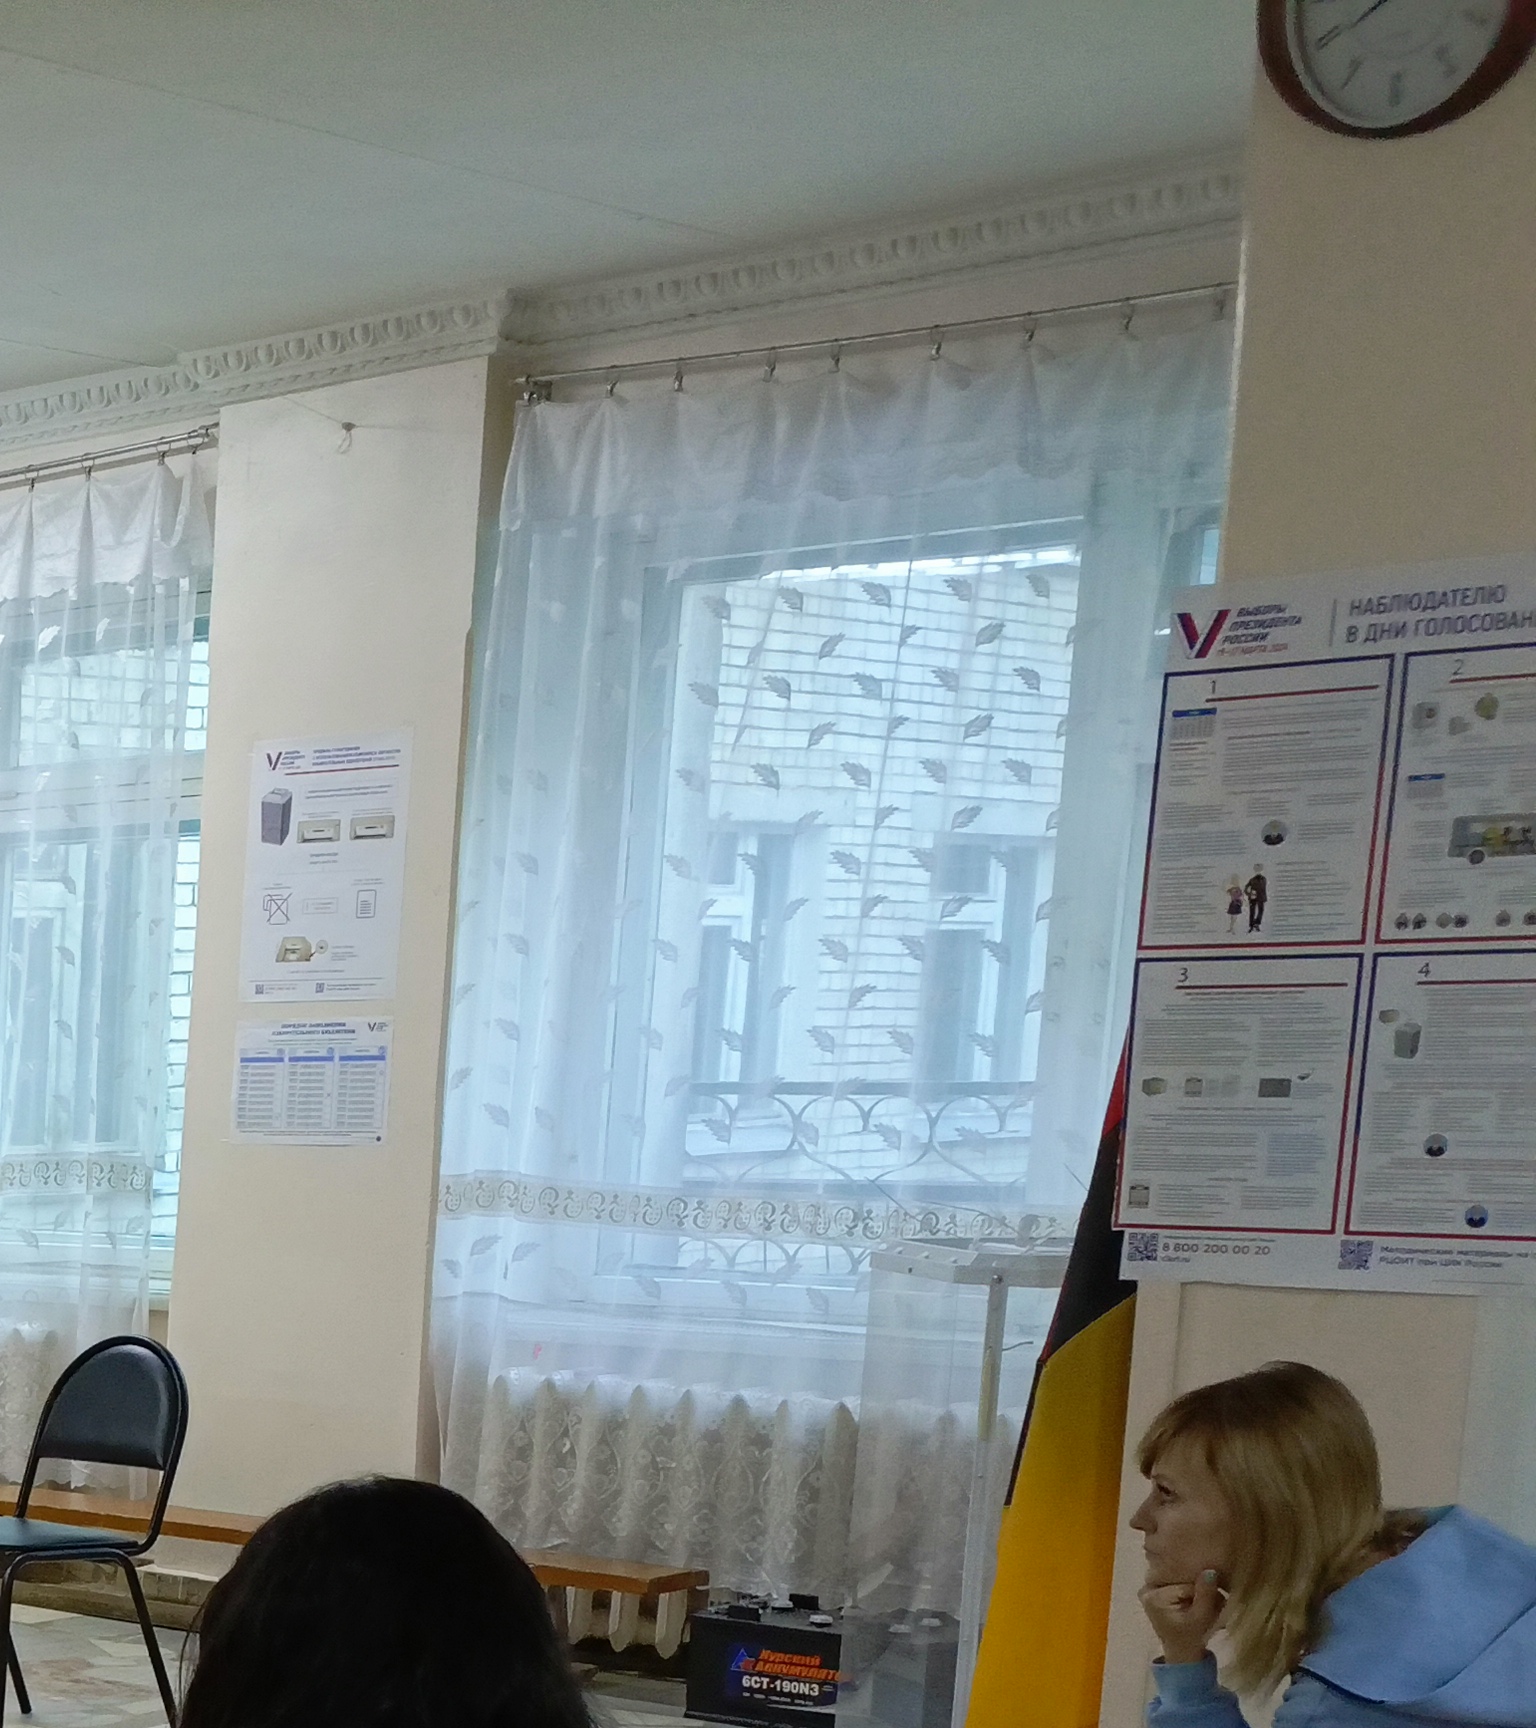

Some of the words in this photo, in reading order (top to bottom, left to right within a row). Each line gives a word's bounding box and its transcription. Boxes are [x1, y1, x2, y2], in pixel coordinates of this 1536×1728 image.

[1349, 584, 1506, 617] НАБЛЮДАТЕЛЮ
[1345, 626, 1360, 644] В
[1363, 621, 1408, 645] ДНИ
[1413, 608, 1536, 638] ГОЛОСОВАН
[1452, 659, 1464, 676] 2
[1177, 967, 1189, 983] 3
[1162, 1242, 1171, 1252] 8
[1203, 1244, 1228, 1254] 200
[1232, 1245, 1250, 1255] 00
[1254, 1245, 1271, 1255] 20
